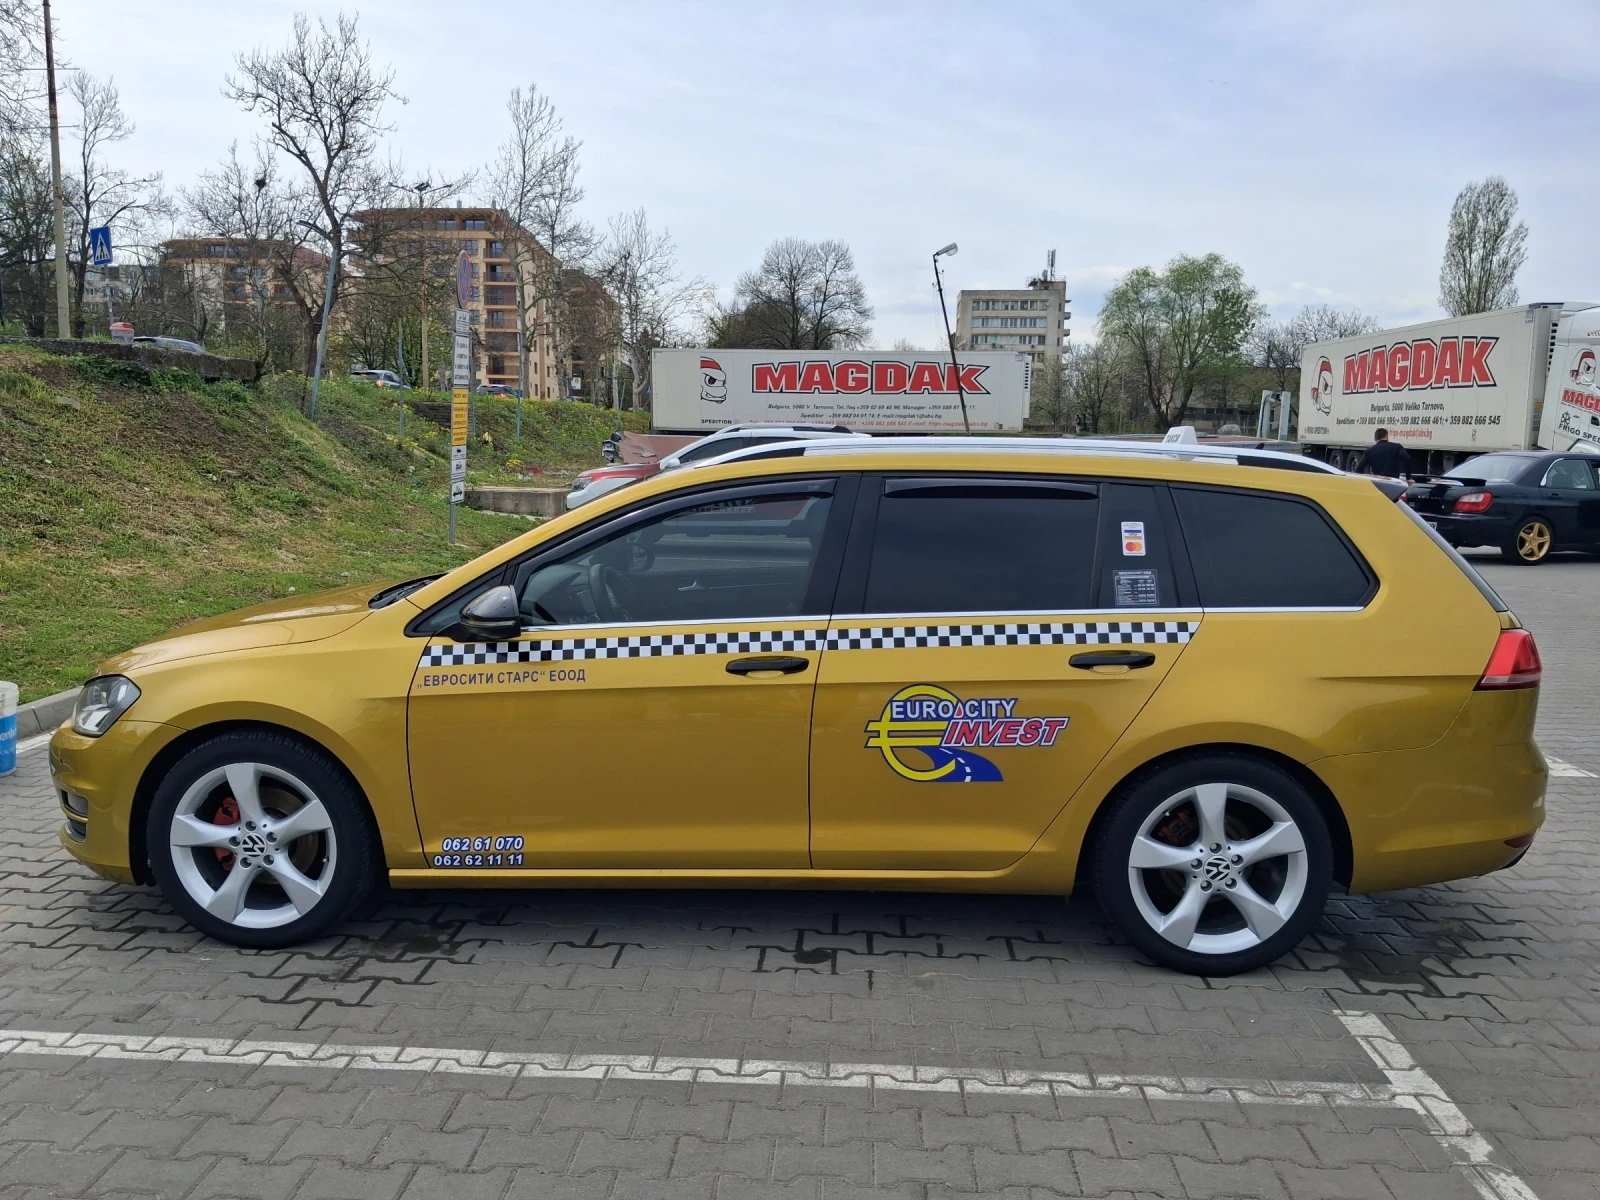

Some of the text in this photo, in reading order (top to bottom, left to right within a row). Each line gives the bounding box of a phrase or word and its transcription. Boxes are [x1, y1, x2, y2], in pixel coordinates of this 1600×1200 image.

[1343, 336, 1500, 395] MAGDAK
[752, 360, 992, 394] MAGDAK
[1392, 402, 1404, 411] 5000
[1559, 423, 1580, 436] FRIGO
[417, 669, 586, 689] „ЕВРОСИТИ СТАРС“ ЕООД
[891, 699, 1017, 719] EURO CITY
[941, 717, 1070, 747] INVEST
[443, 836, 524, 851] 062 61 070
[434, 853, 523, 866] 062 62 11 11
